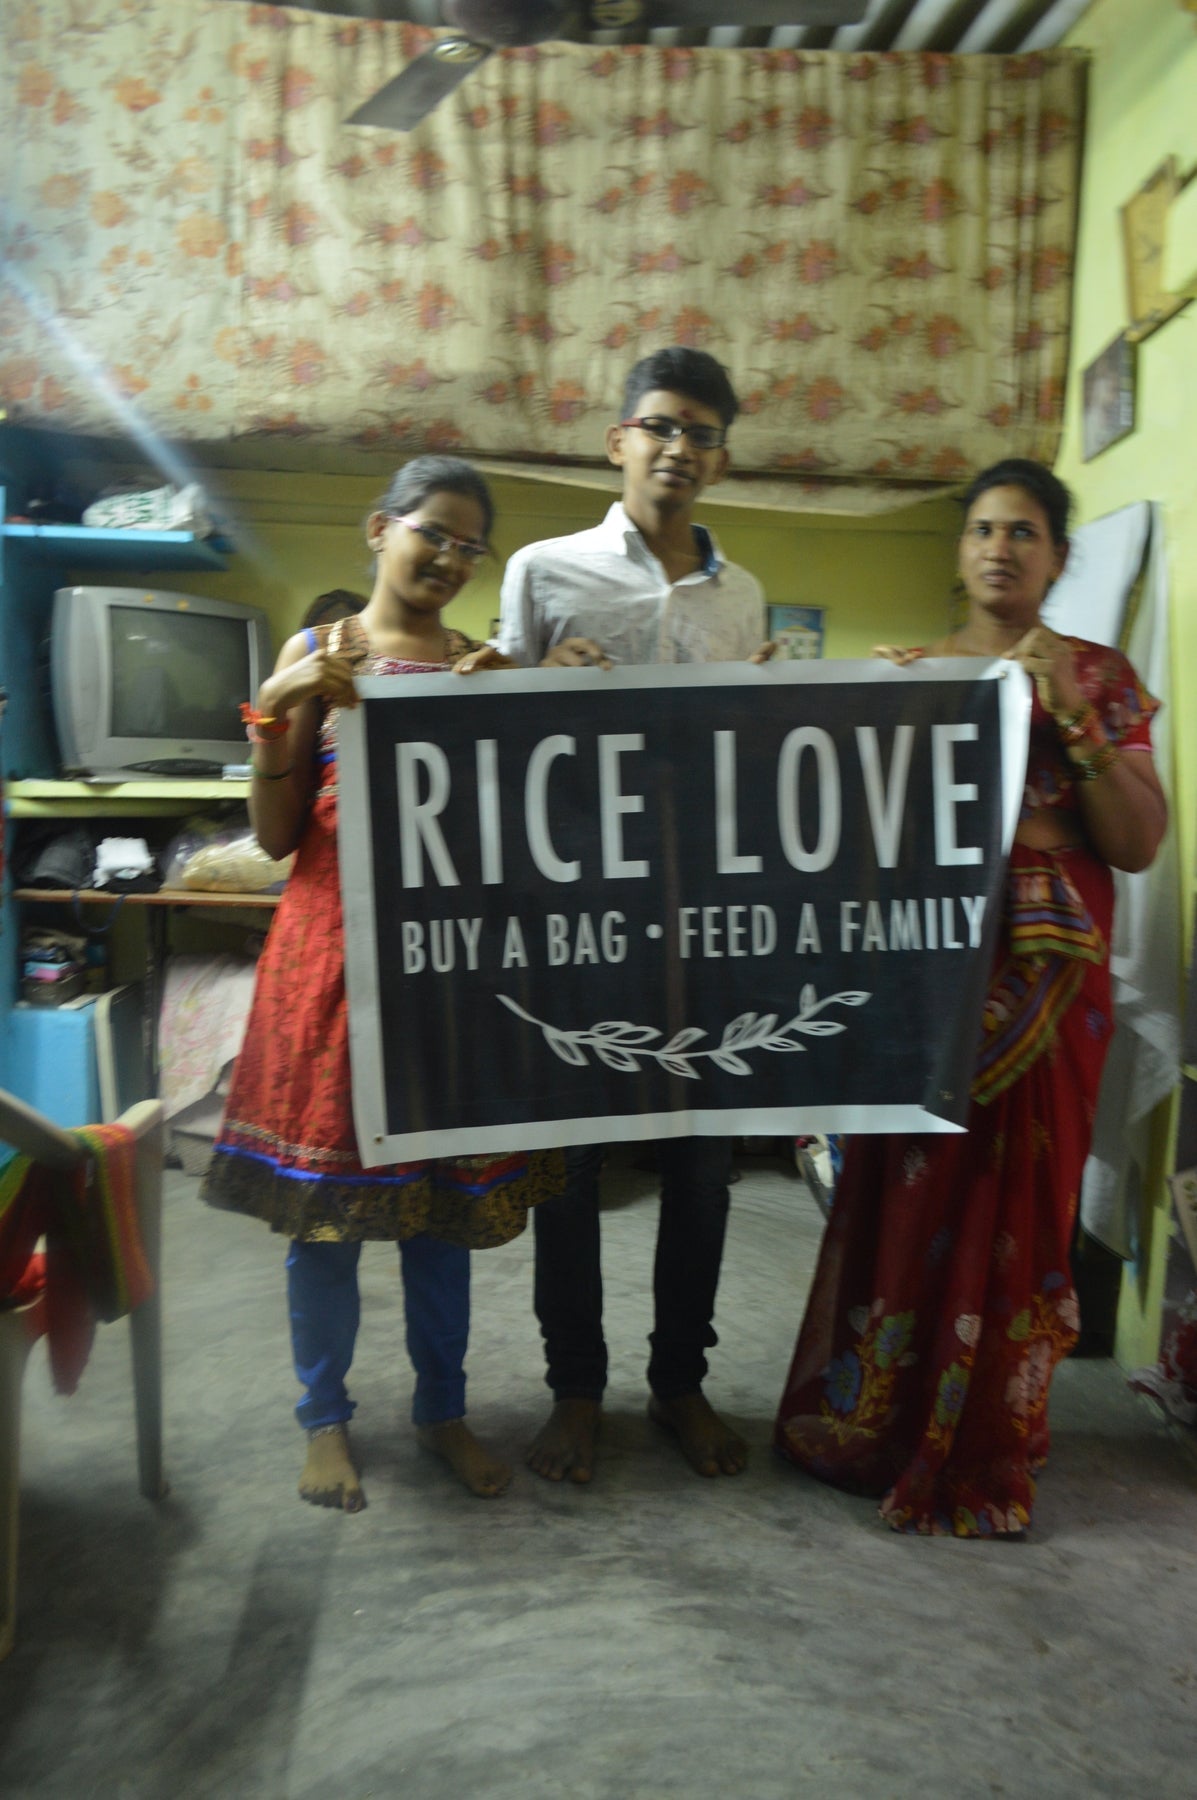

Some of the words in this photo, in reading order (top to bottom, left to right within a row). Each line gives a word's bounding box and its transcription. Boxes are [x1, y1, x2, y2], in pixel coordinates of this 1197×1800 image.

[396, 734, 649, 888] RICE
[715, 723, 983, 873] LOVE
[402, 918, 481, 973] BUY
[503, 917, 527, 968] A
[547, 911, 626, 965] BAG
[679, 905, 776, 958] FEED
[797, 903, 820, 953] A
[841, 896, 988, 952] FAMILY
